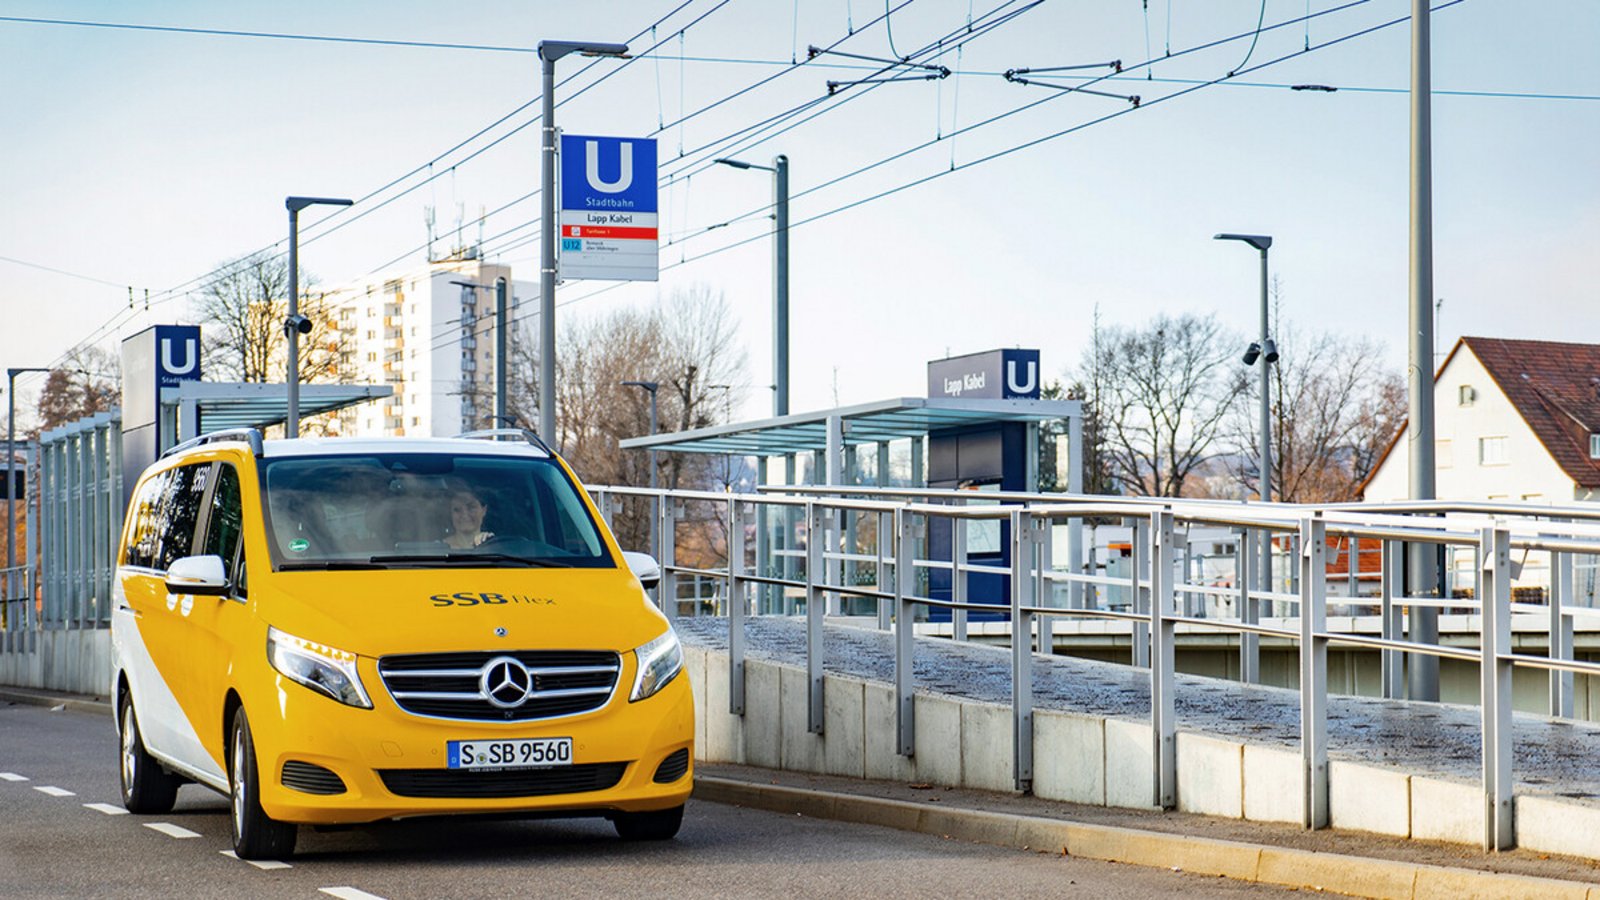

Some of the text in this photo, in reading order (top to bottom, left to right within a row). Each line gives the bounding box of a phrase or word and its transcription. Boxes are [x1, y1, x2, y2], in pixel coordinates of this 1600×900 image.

[586, 140, 633, 193] U
[586, 197, 634, 208] Stadtbahn
[587, 214, 633, 224] Lapp Kabel
[563, 240, 580, 250] U12
[161, 338, 196, 374] U
[944, 372, 985, 396] Lapp Kabel
[1008, 360, 1036, 393] U
[430, 592, 557, 607] SSB Flex
[461, 741, 569, 764] S SB 9560
